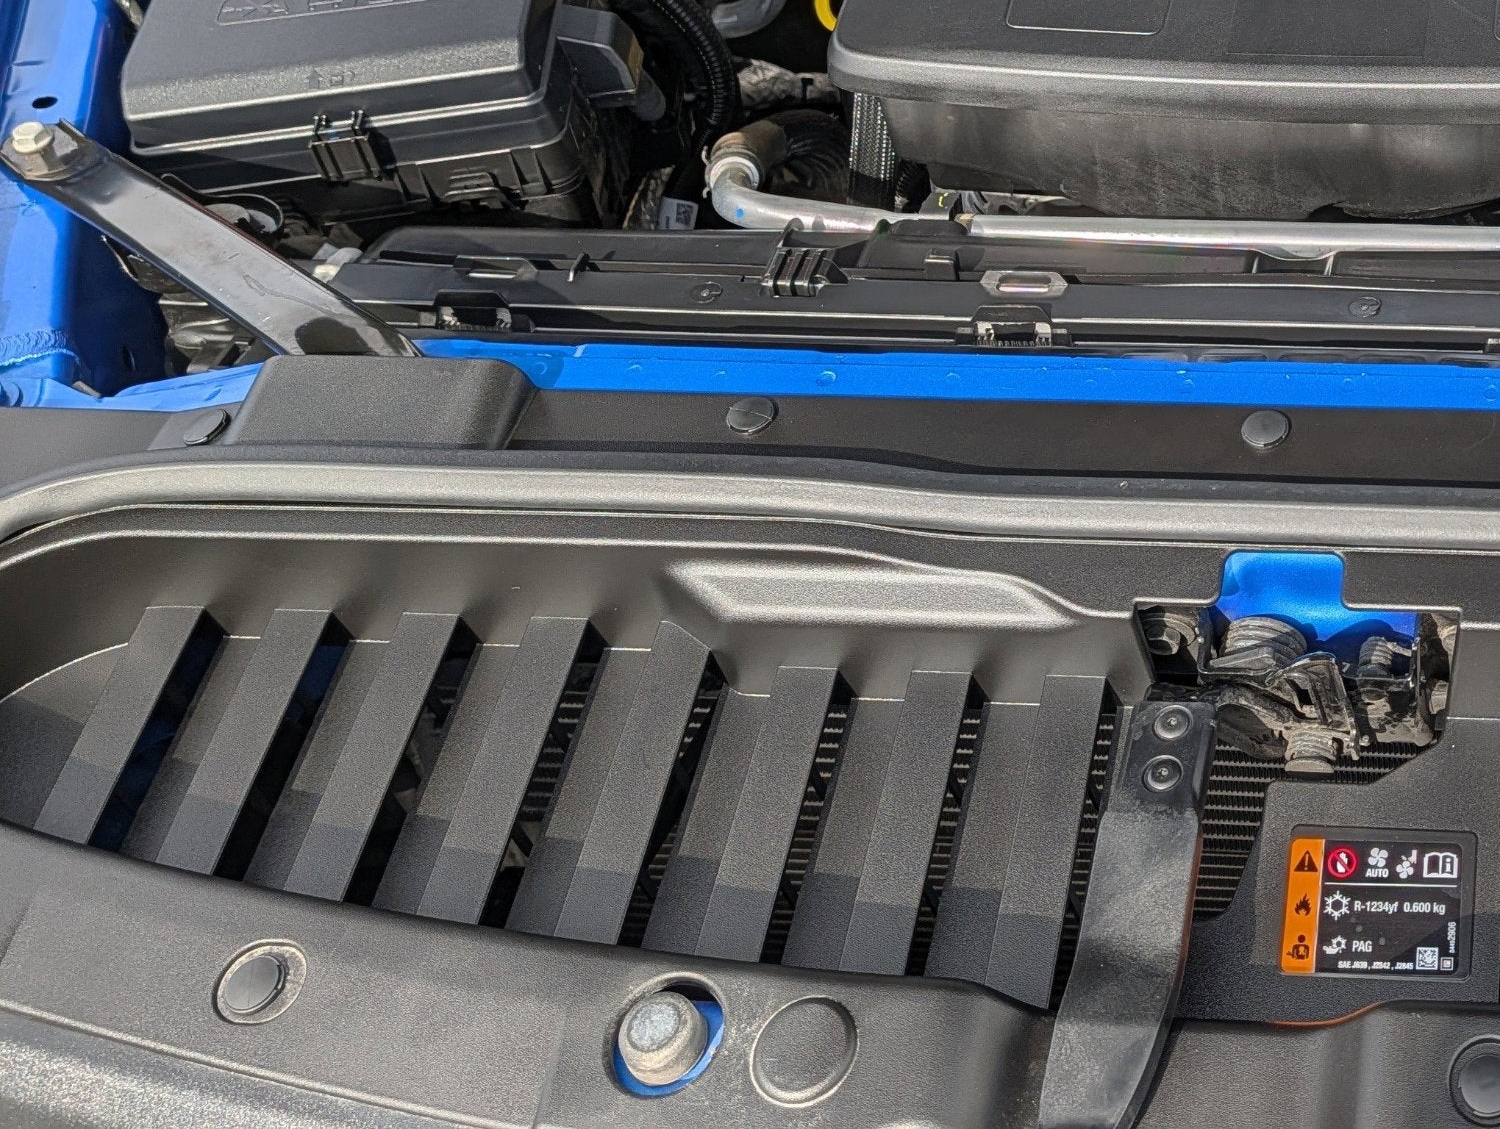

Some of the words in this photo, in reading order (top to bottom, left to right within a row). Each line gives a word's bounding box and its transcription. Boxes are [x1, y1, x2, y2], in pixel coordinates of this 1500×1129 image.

[1365, 868, 1389, 878] AUTO
[1354, 900, 1399, 915] R-1234yf
[1403, 902, 1431, 913] 0.600
[1433, 902, 1446, 915] kg
[1352, 940, 1373, 952] PAG
